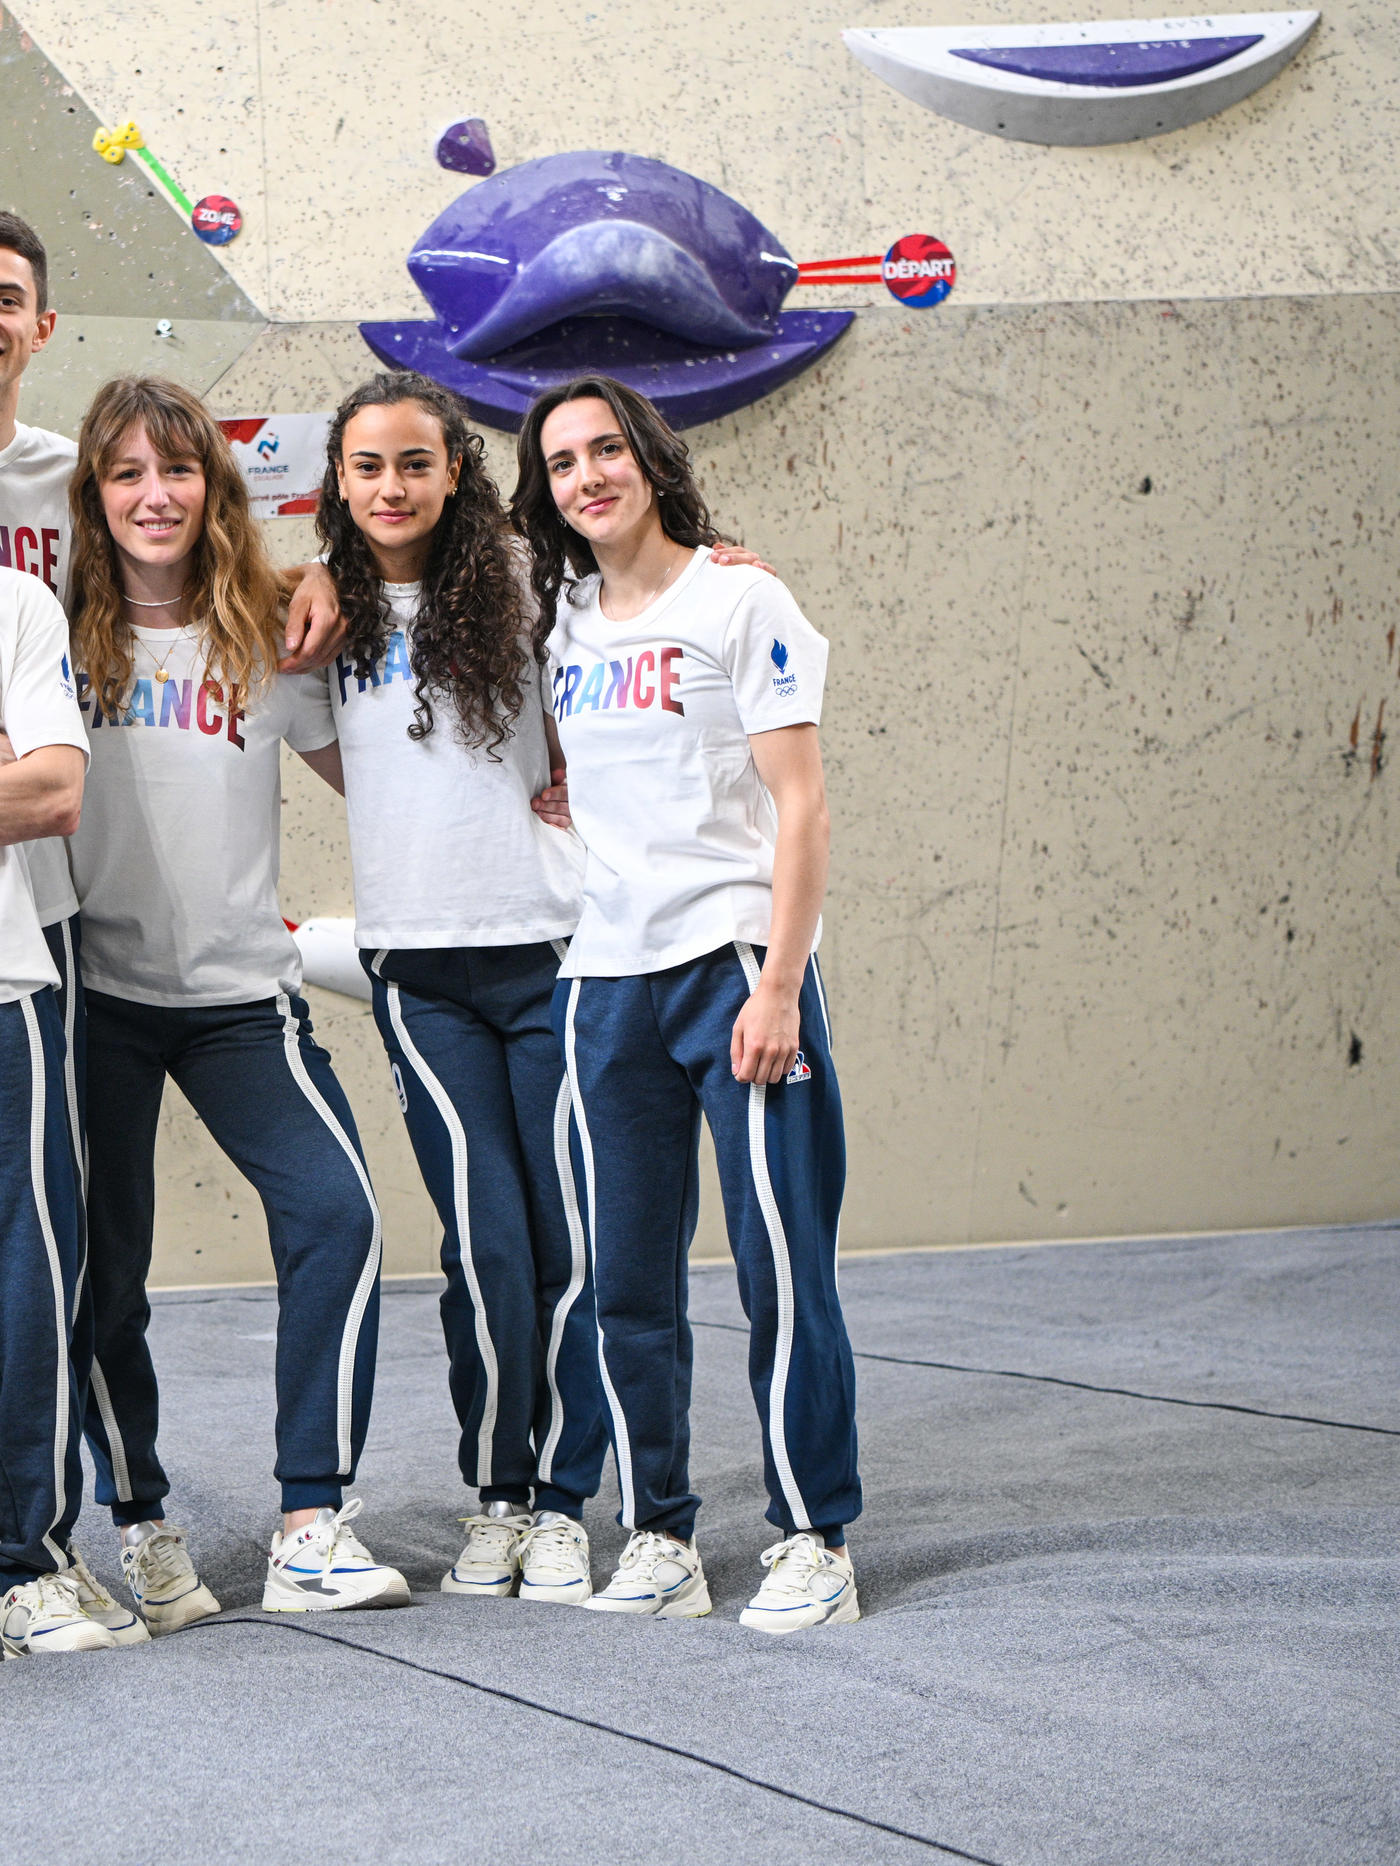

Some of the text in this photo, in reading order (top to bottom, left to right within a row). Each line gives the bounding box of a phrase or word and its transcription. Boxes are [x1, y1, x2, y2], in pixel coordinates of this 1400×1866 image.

[198, 208, 236, 225] ZONE
[884, 257, 954, 279] DÉPART
[248, 465, 289, 475] FRANCE
[552, 647, 686, 723] FRANCE
[772, 674, 797, 687] FRANCE
